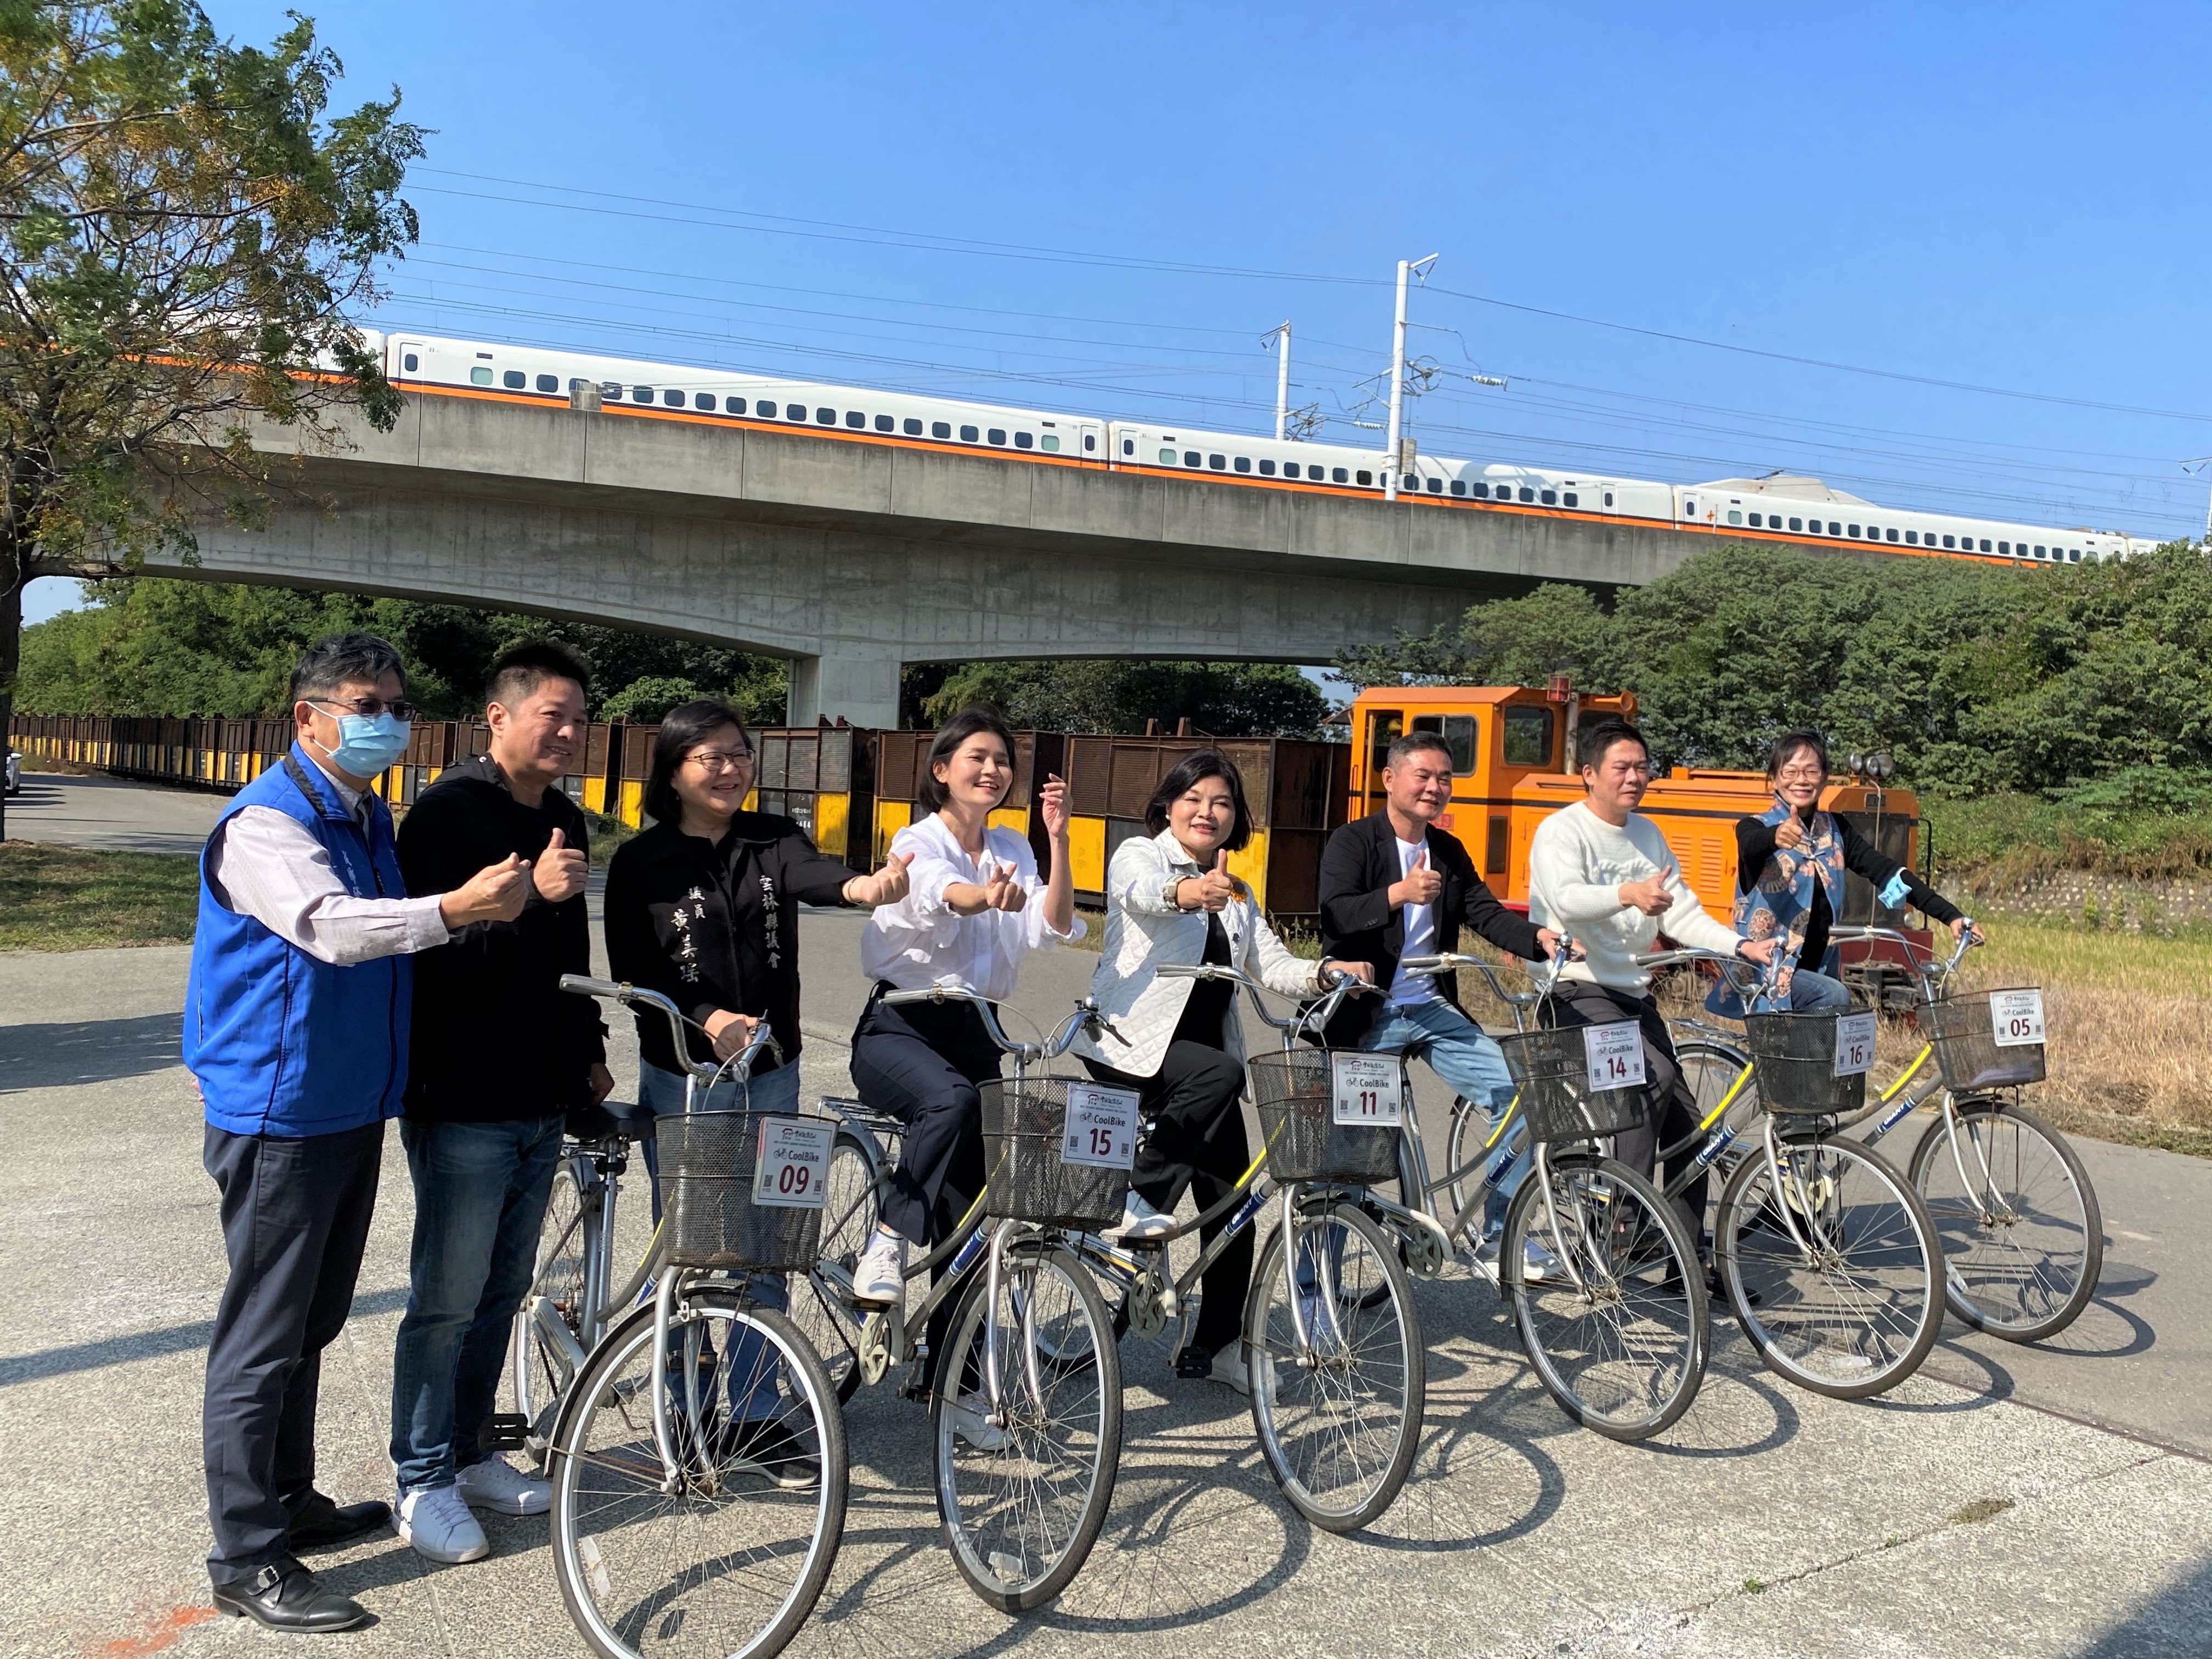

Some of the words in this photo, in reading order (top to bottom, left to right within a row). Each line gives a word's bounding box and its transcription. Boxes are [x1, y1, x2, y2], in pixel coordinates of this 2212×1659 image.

[2011, 1018, 2030, 1037] 05
[1609, 1045, 1633, 1054] CoolBike
[1850, 1045, 1863, 1065] 16
[1607, 1057, 1627, 1079] 14
[1359, 1079, 1390, 1088] CoolBike
[1360, 1091, 1376, 1115] 11
[1094, 1114, 1126, 1127] CoolBike
[1090, 1128, 1112, 1156] 15
[788, 1150, 820, 1163] CoolBike
[779, 1165, 809, 1194] 09
